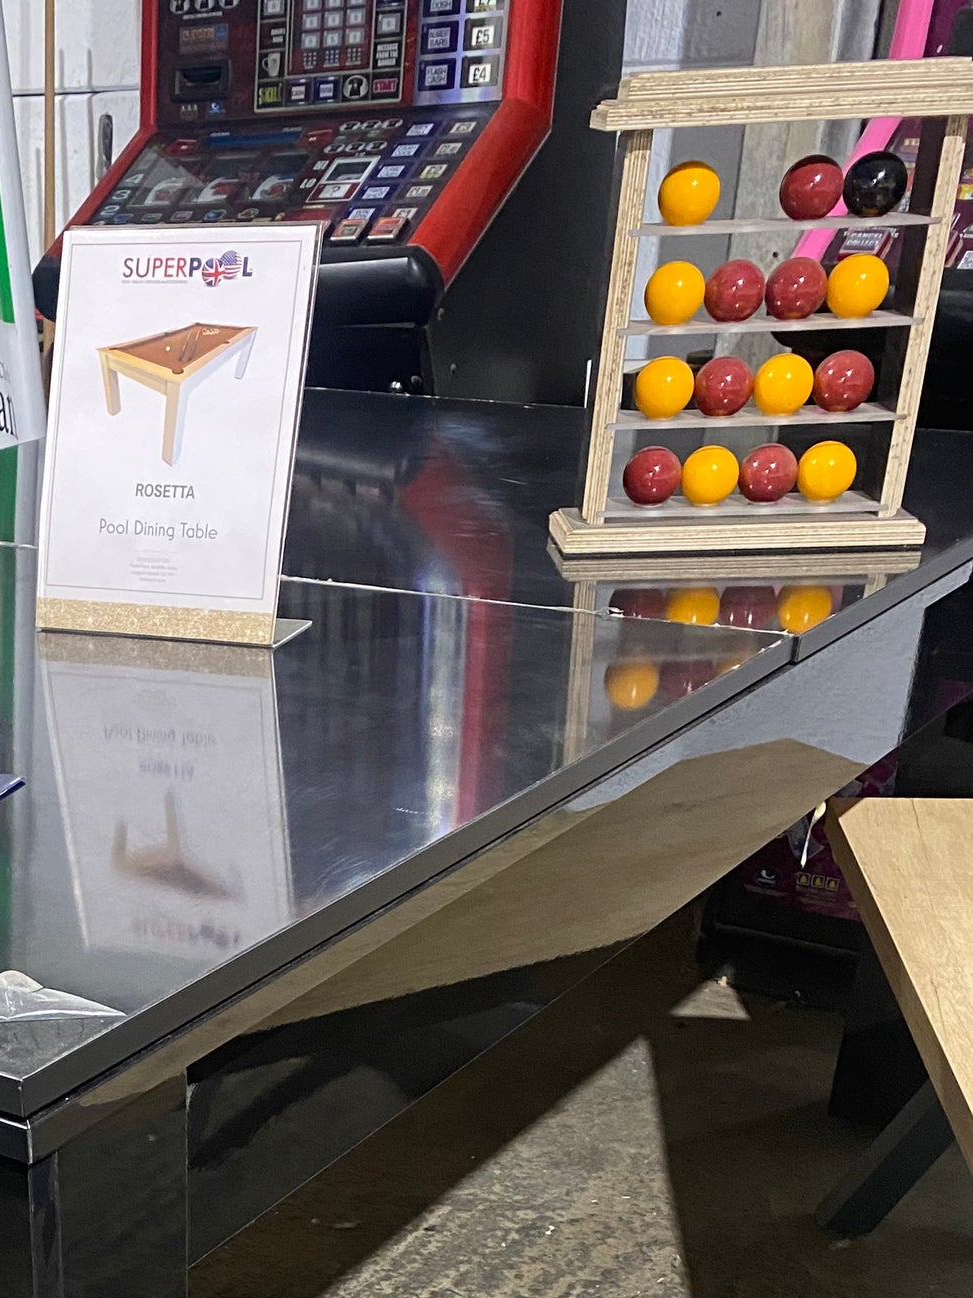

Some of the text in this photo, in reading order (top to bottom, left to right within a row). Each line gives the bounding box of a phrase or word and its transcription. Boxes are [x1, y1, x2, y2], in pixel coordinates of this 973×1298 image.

[475, 28, 490, 44] £5
[472, 66, 487, 82] £4
[112, 189, 131, 200] 3
[100, 205, 120, 216] 2
[135, 483, 195, 499] ROSETTA
[99, 518, 218, 541] Pool Dining Table
